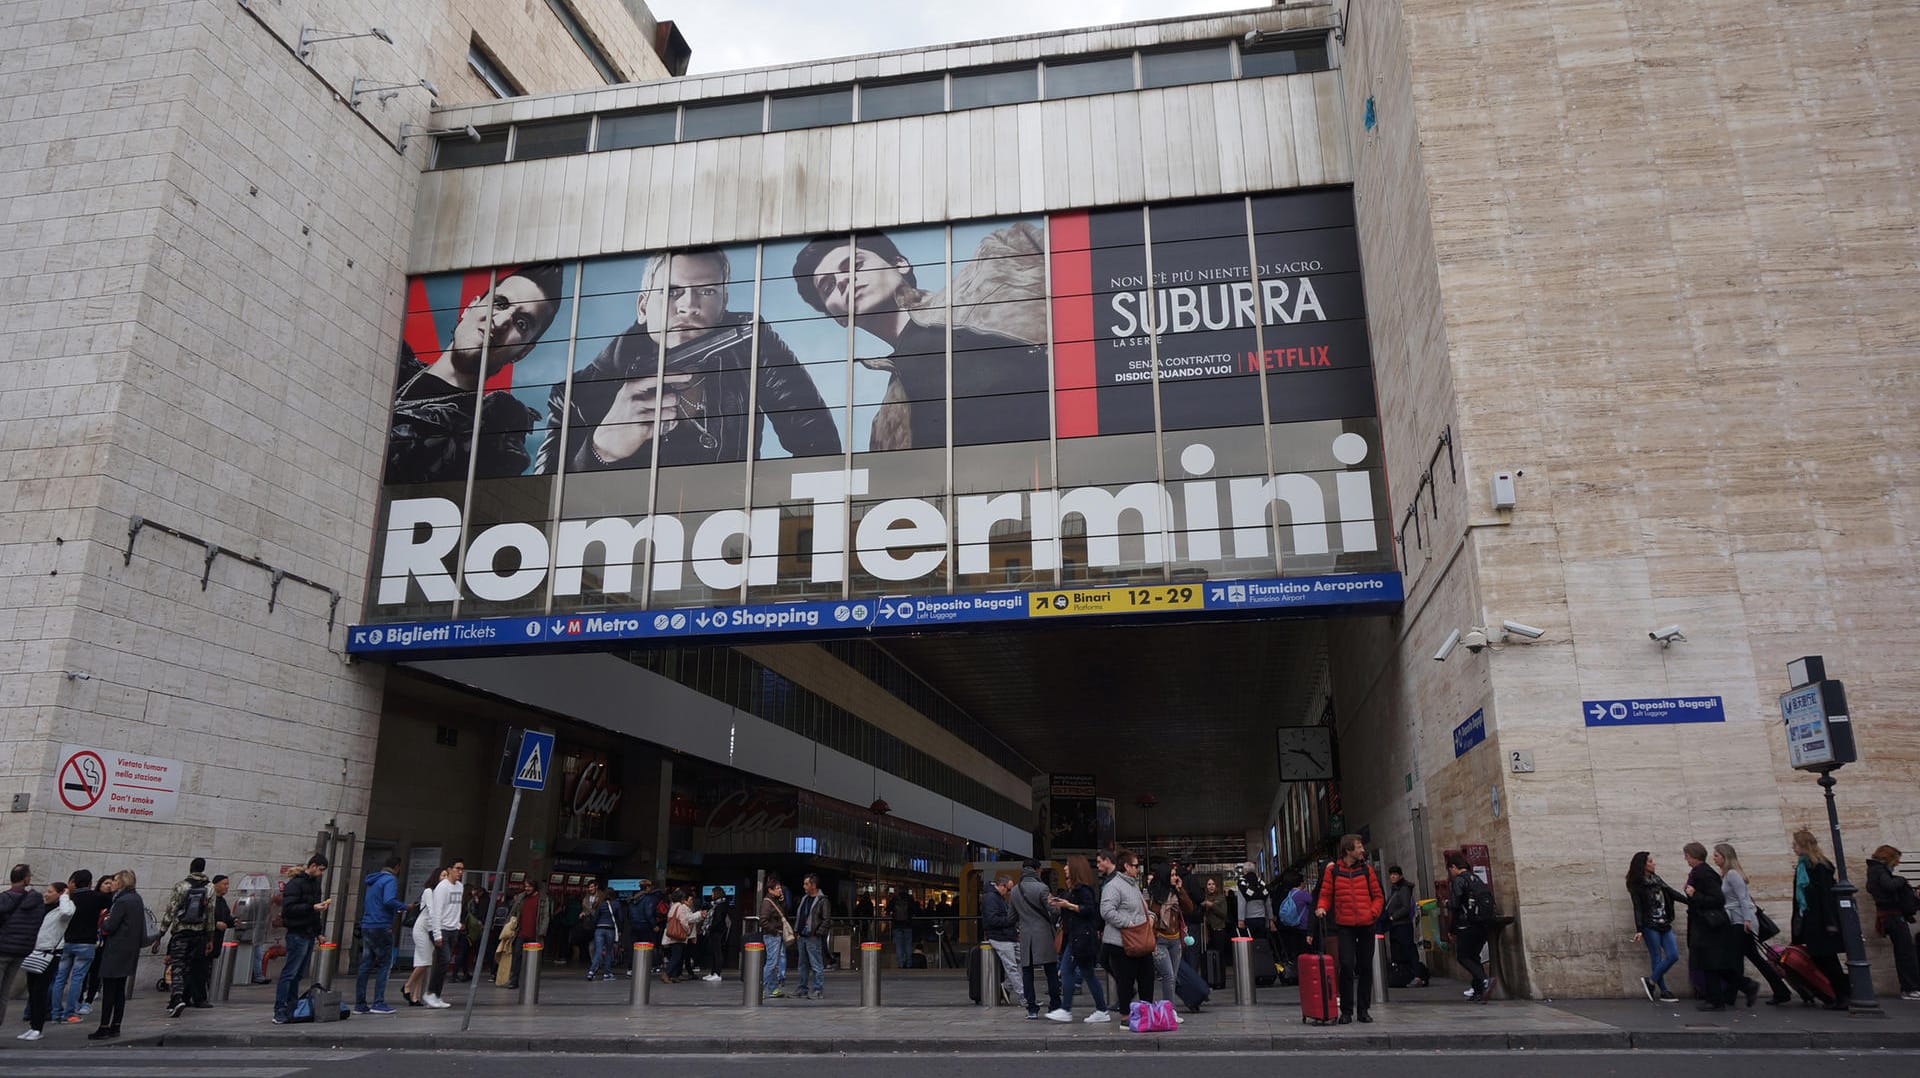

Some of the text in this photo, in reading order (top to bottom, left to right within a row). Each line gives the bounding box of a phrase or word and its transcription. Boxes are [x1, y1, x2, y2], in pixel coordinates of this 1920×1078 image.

[1111, 276, 1143, 288] NON
[1172, 270, 1193, 283] PIÙ
[1198, 266, 1249, 281] NIENTE
[1275, 260, 1323, 274] SACRO.
[1111, 277, 1327, 337] SUBURRA
[1114, 336, 1162, 347] LA SERE
[1166, 354, 1231, 367] CONTRATTO
[1248, 345, 1331, 372] NETFLIX
[1205, 365, 1232, 375] VUOI
[1249, 579, 1383, 595] Fiumicino Aeroporto
[1073, 592, 1111, 603] Binari
[1250, 594, 1306, 603] Fiumicino Airport
[917, 596, 1022, 613] Deposito Bagagli
[732, 607, 819, 628] Shopping
[930, 611, 957, 620] Luggage
[568, 618, 639, 633] M Metro
[386, 624, 496, 645] Biglietti Tickets
[1632, 699, 1717, 711] Deposito Bagagli
[1512, 751, 1521, 761] 2
[117, 758, 167, 772] Vietato fumare
[115, 770, 162, 782] nella stazione
[573, 761, 622, 815] Ciao
[111, 793, 154, 804] Don't smoke
[109, 804, 153, 816] in the station
[705, 790, 797, 838] Ciao
